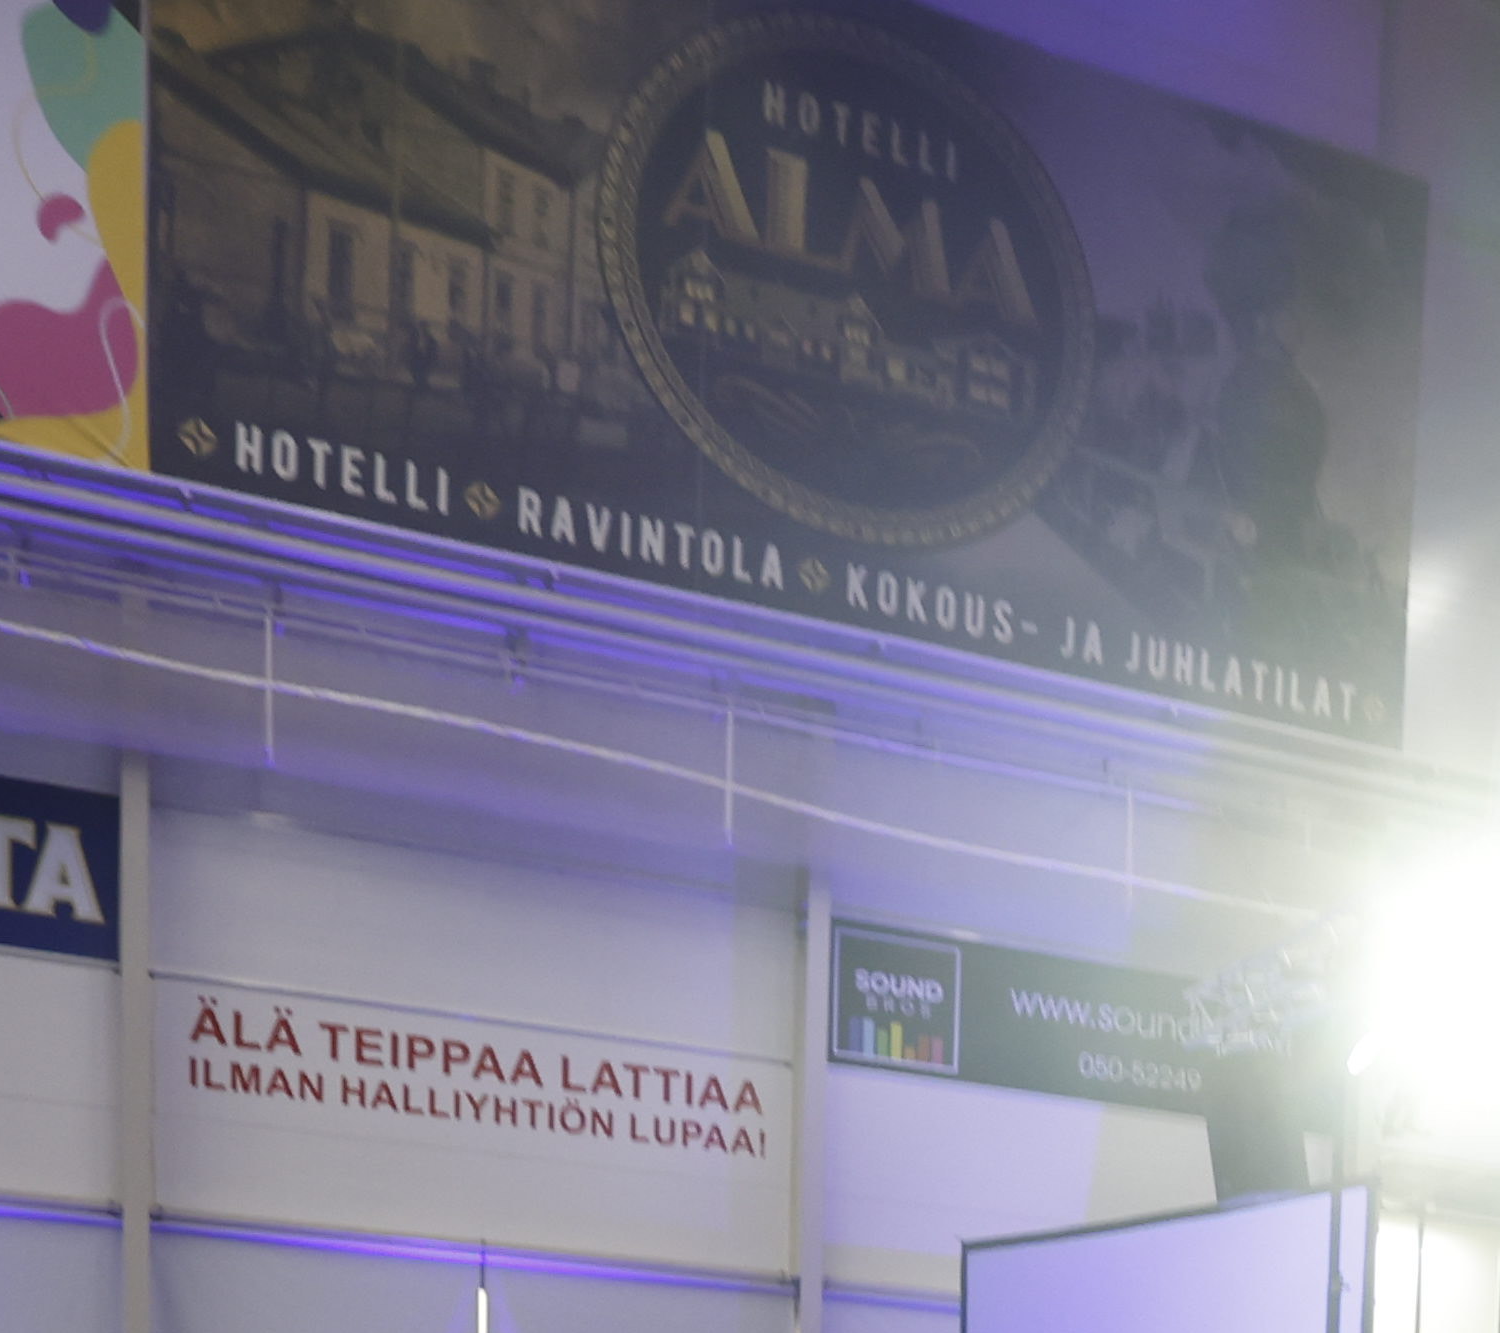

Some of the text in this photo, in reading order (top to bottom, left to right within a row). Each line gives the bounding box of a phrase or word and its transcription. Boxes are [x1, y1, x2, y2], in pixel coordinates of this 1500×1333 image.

[762, 79, 957, 183] HOTELLI
[234, 420, 1358, 722] HOTELLI RAVINTOLA KOKOUS- JA JUHLATILAT
[854, 967, 945, 1005] SOUND
[188, 995, 765, 1116] ÄLÄ TEIPPAA LATTIAA
[188, 1056, 768, 1160] ILMAN HALLIYHTIÖN LUPAA!
